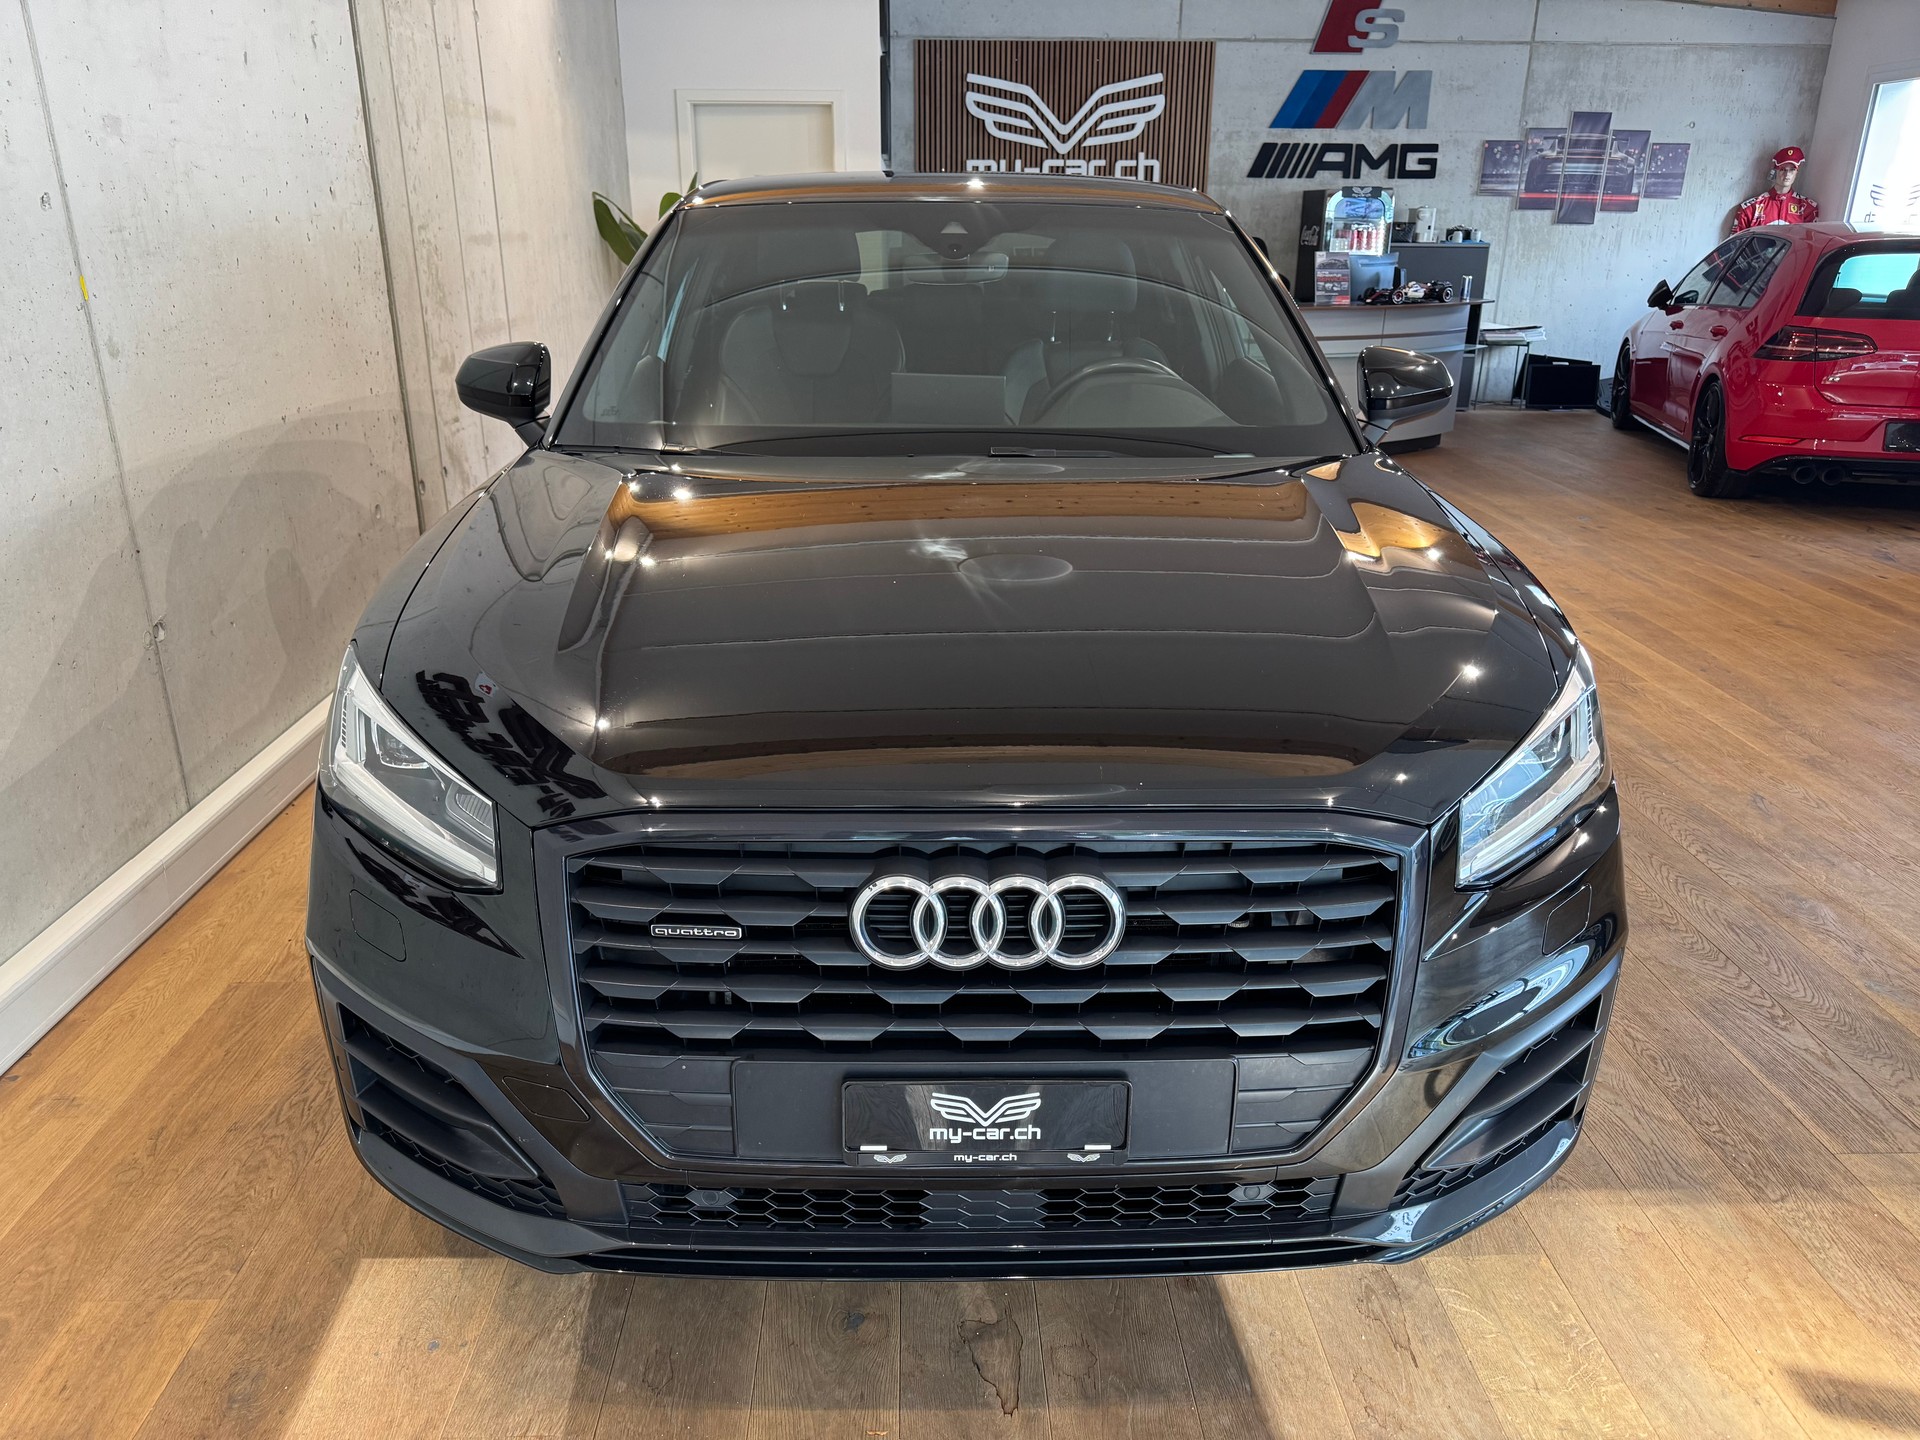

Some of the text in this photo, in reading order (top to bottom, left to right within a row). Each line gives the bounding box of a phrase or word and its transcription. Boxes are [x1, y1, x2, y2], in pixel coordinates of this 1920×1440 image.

[1348, 8, 1405, 48] S
[1335, 70, 1432, 129] M
[655, 928, 737, 936] quattro
[929, 1125, 1041, 1143] my-car.ch
[953, 1153, 1018, 1163] my-car.ch
